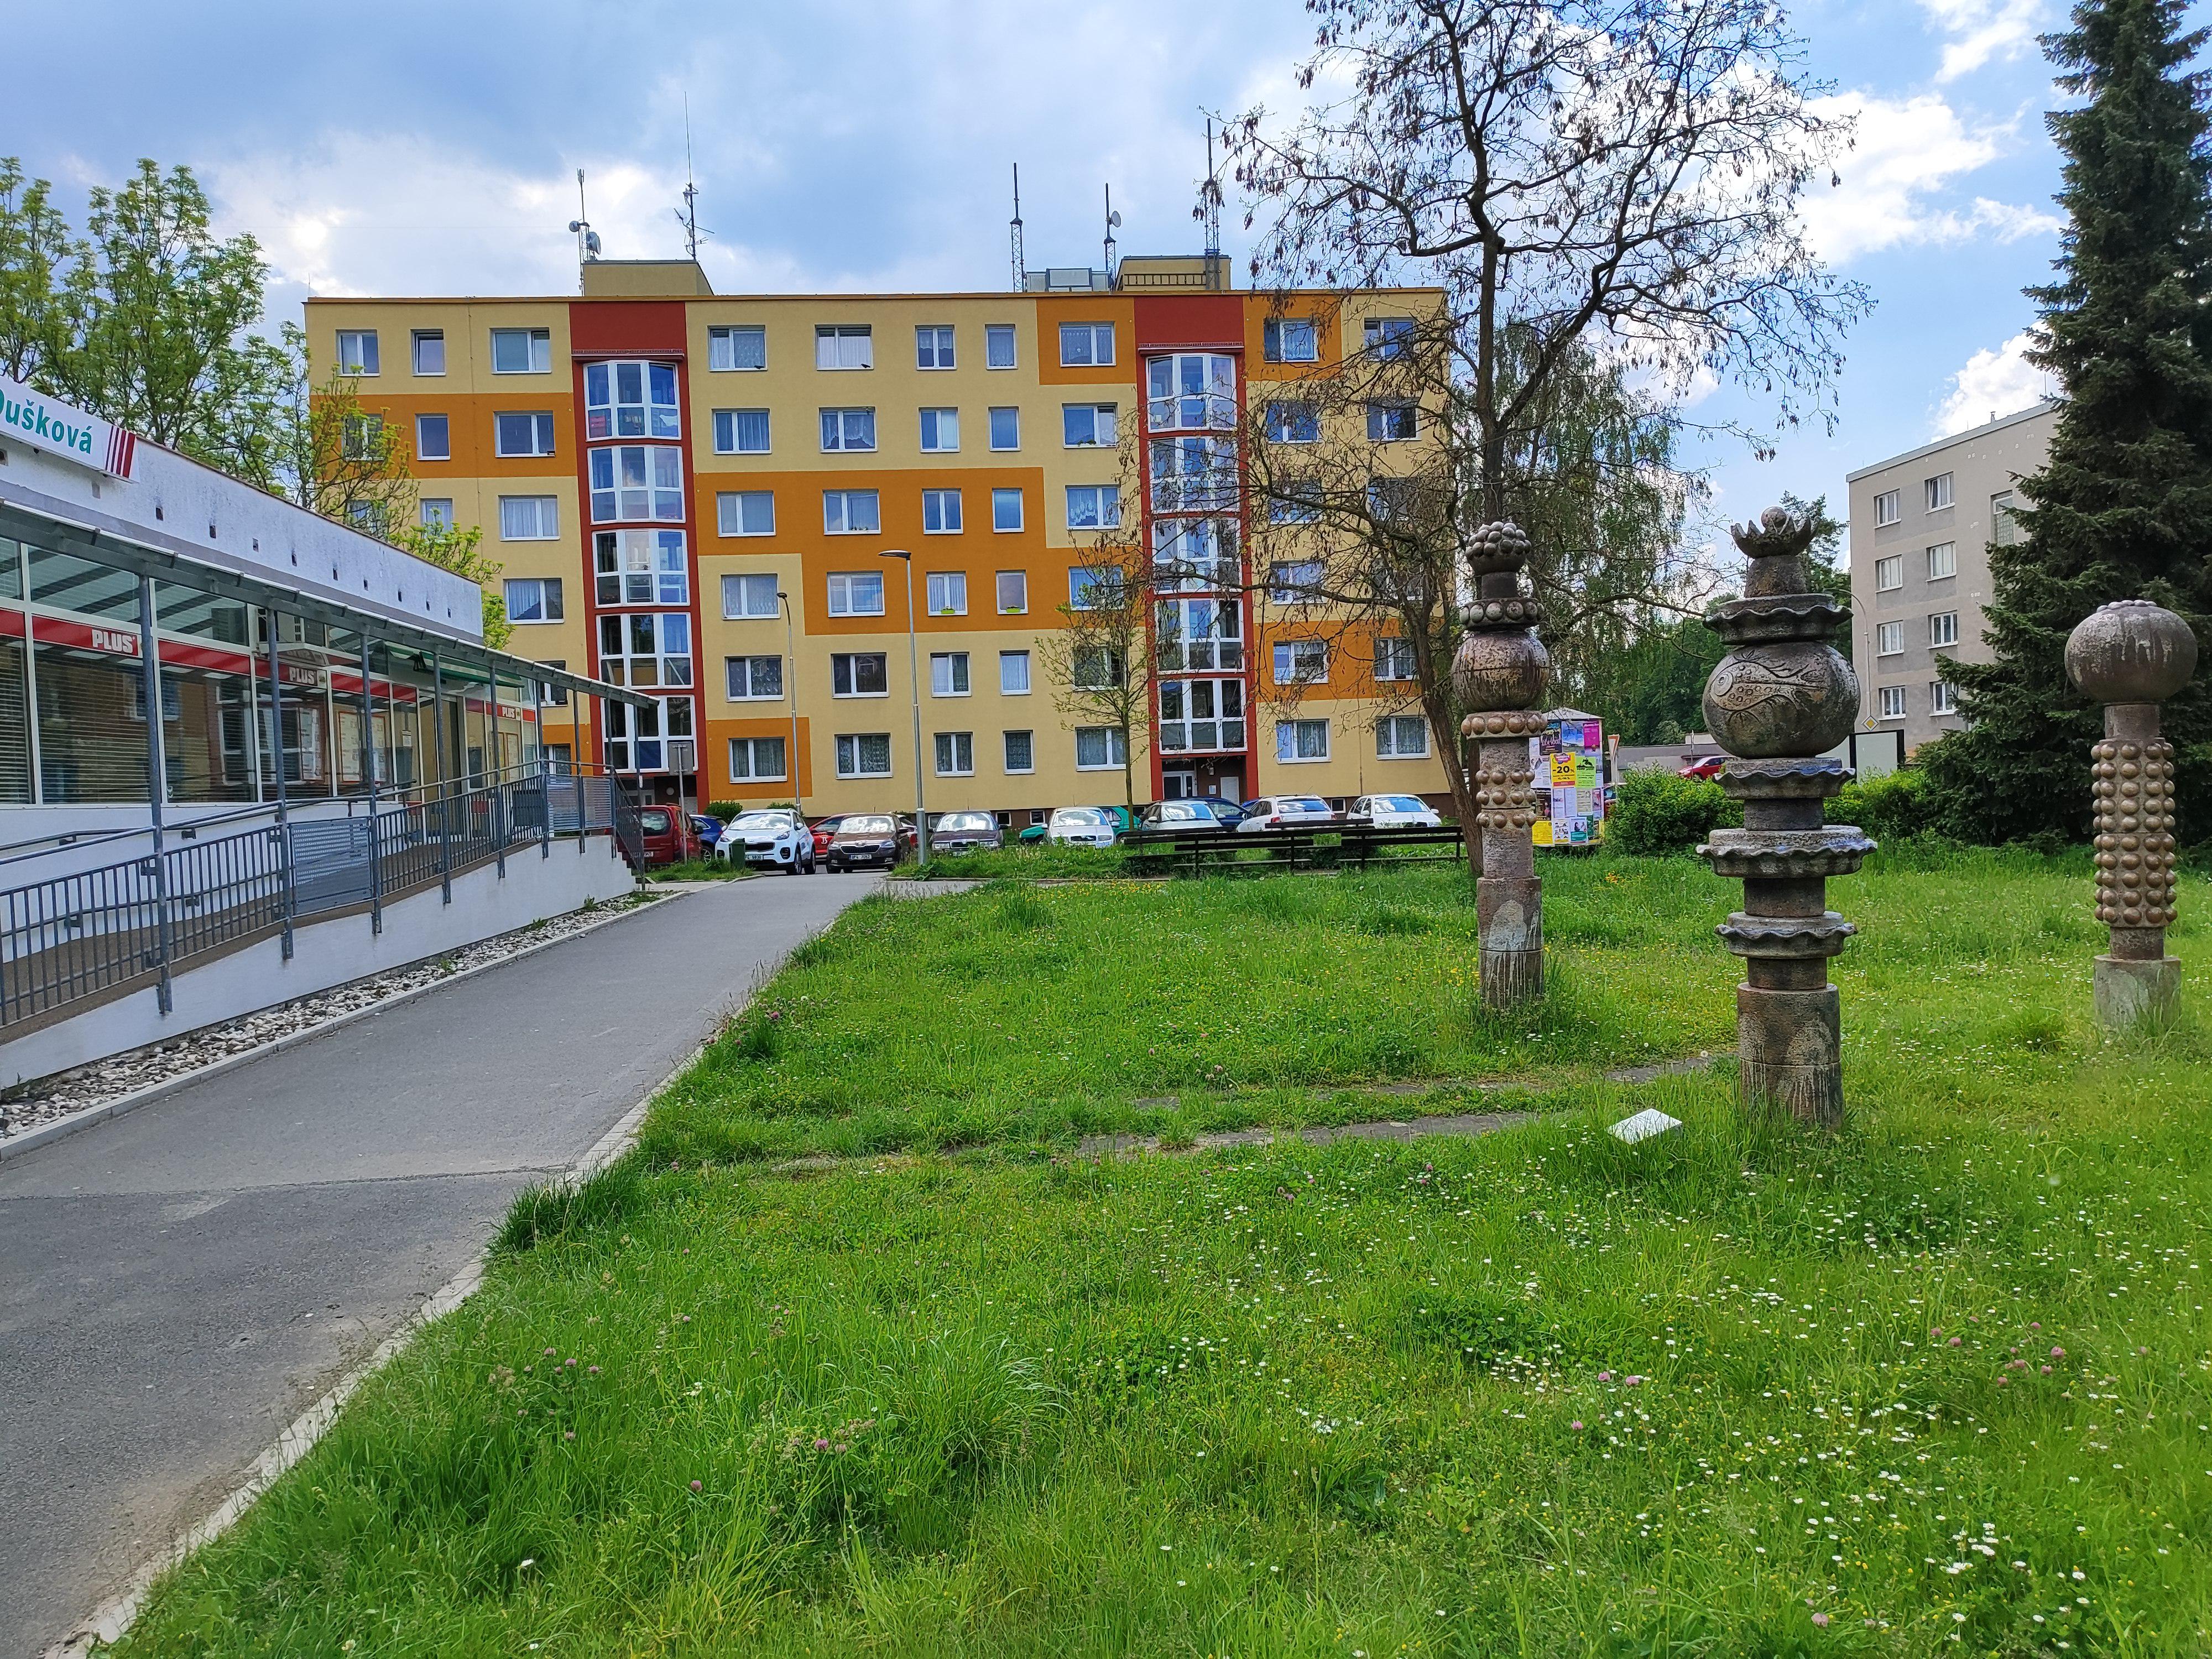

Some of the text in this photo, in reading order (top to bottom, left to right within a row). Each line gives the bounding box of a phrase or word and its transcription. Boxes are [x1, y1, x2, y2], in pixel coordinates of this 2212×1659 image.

[92, 629, 133, 653] PLUS
[289, 667, 314, 684] PLUS
[502, 707, 515, 718] PLUS
